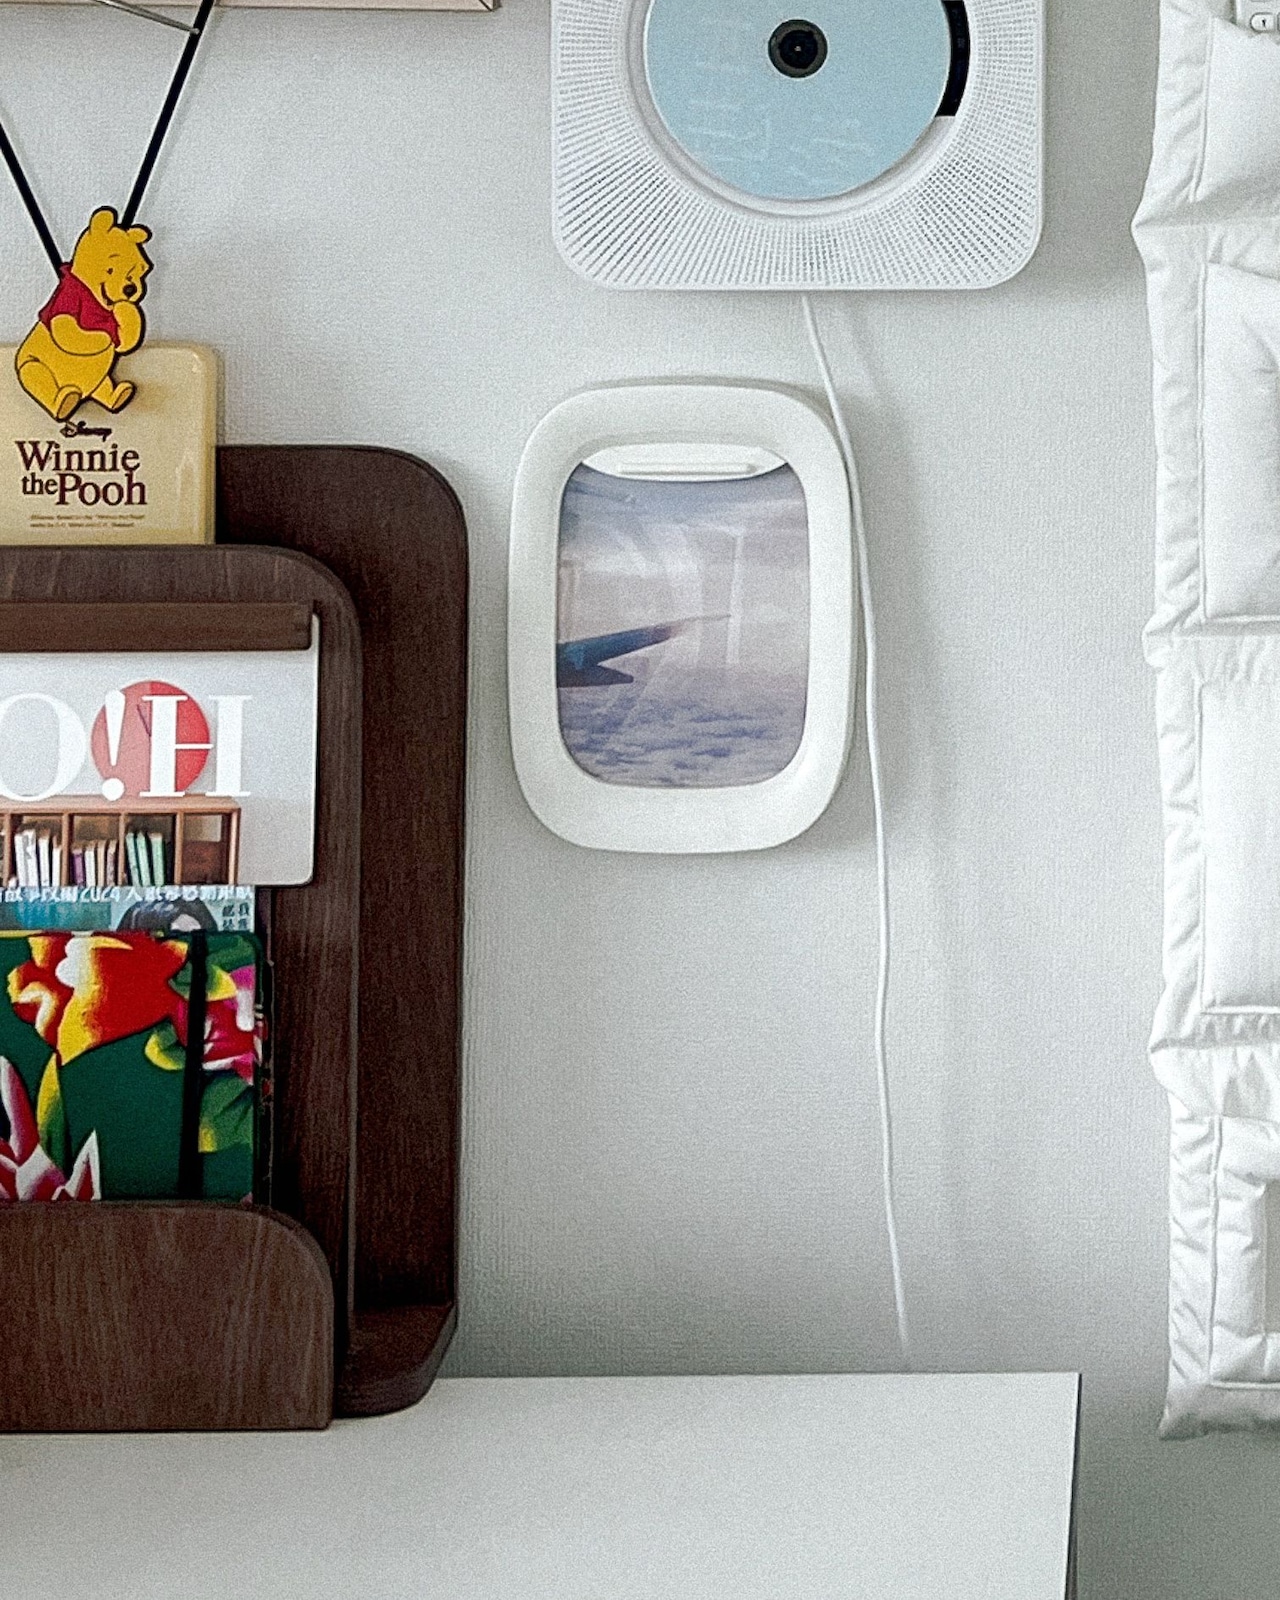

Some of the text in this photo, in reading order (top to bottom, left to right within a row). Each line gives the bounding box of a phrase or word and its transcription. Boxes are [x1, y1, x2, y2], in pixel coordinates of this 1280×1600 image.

[1262, 19, 1267, 28] 1
[15, 440, 140, 472] Winnie
[22, 471, 147, 506] the Pooh
